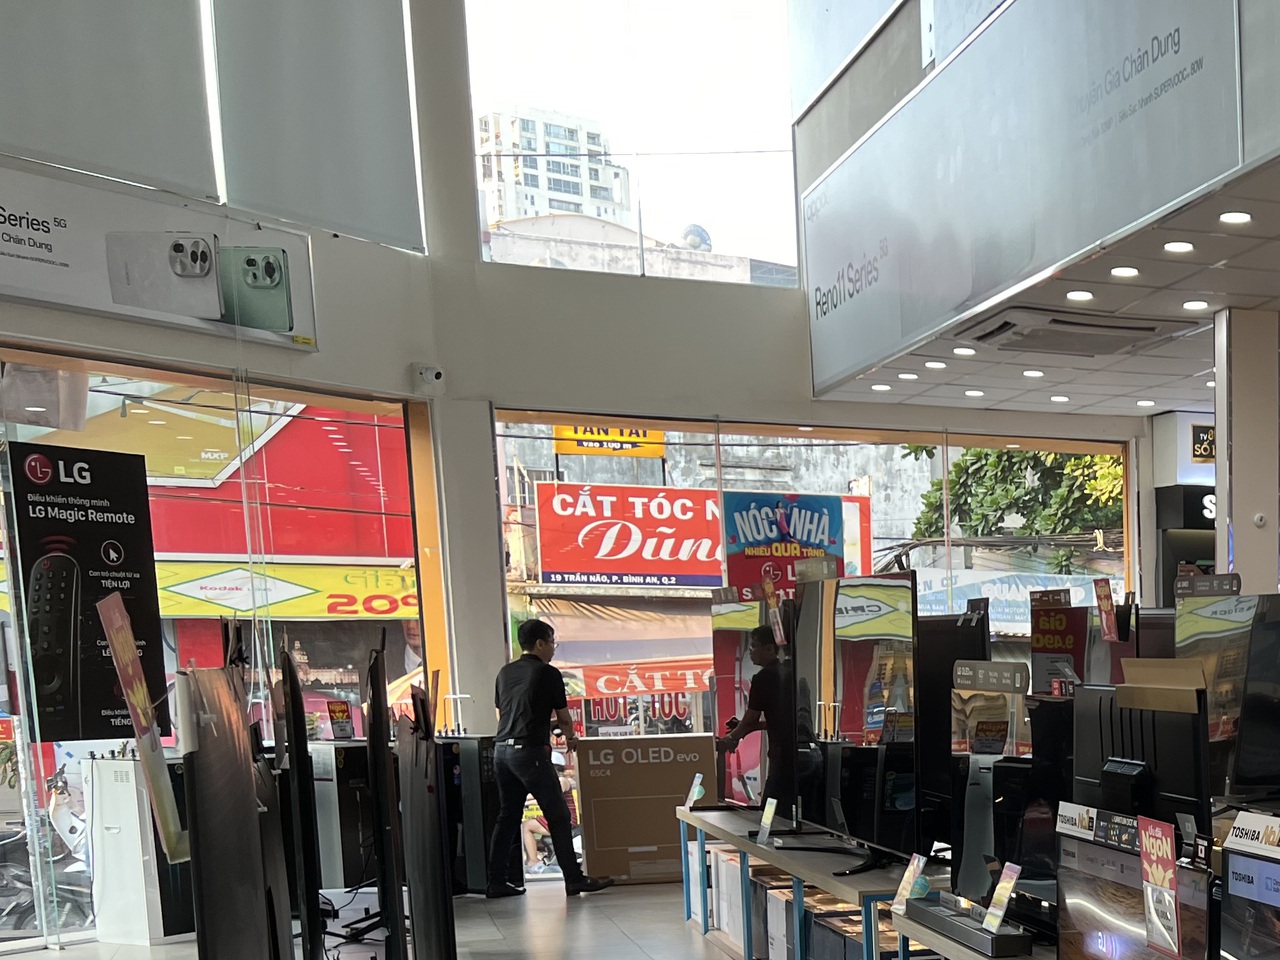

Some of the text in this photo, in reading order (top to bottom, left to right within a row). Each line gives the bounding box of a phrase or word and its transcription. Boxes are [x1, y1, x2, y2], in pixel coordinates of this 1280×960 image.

[1122, 47, 1149, 82] Chân
[1151, 26, 1180, 64] Dung
[53, 217, 67, 229] 5G
[1, 232, 53, 253] Chân Dung
[815, 253, 879, 321] Reno11 Series
[58, 460, 91, 484] LG
[552, 486, 694, 520] CẮT TÓC
[28, 505, 136, 524] LG Magic Remote
[734, 502, 830, 546] NÓC NHÀ
[550, 574, 562, 582] 19
[612, 575, 621, 583] P.
[645, 576, 660, 584] AN,
[662, 576, 676, 584] Q.2
[596, 665, 670, 694] CẮT
[588, 747, 699, 765] LG OLED evo
[1058, 813, 1077, 826] TOSHIBA
[1231, 825, 1260, 842] TOSHIBA
[1142, 830, 1171, 861] NgoN
[1232, 871, 1255, 886] TOSHIBA
